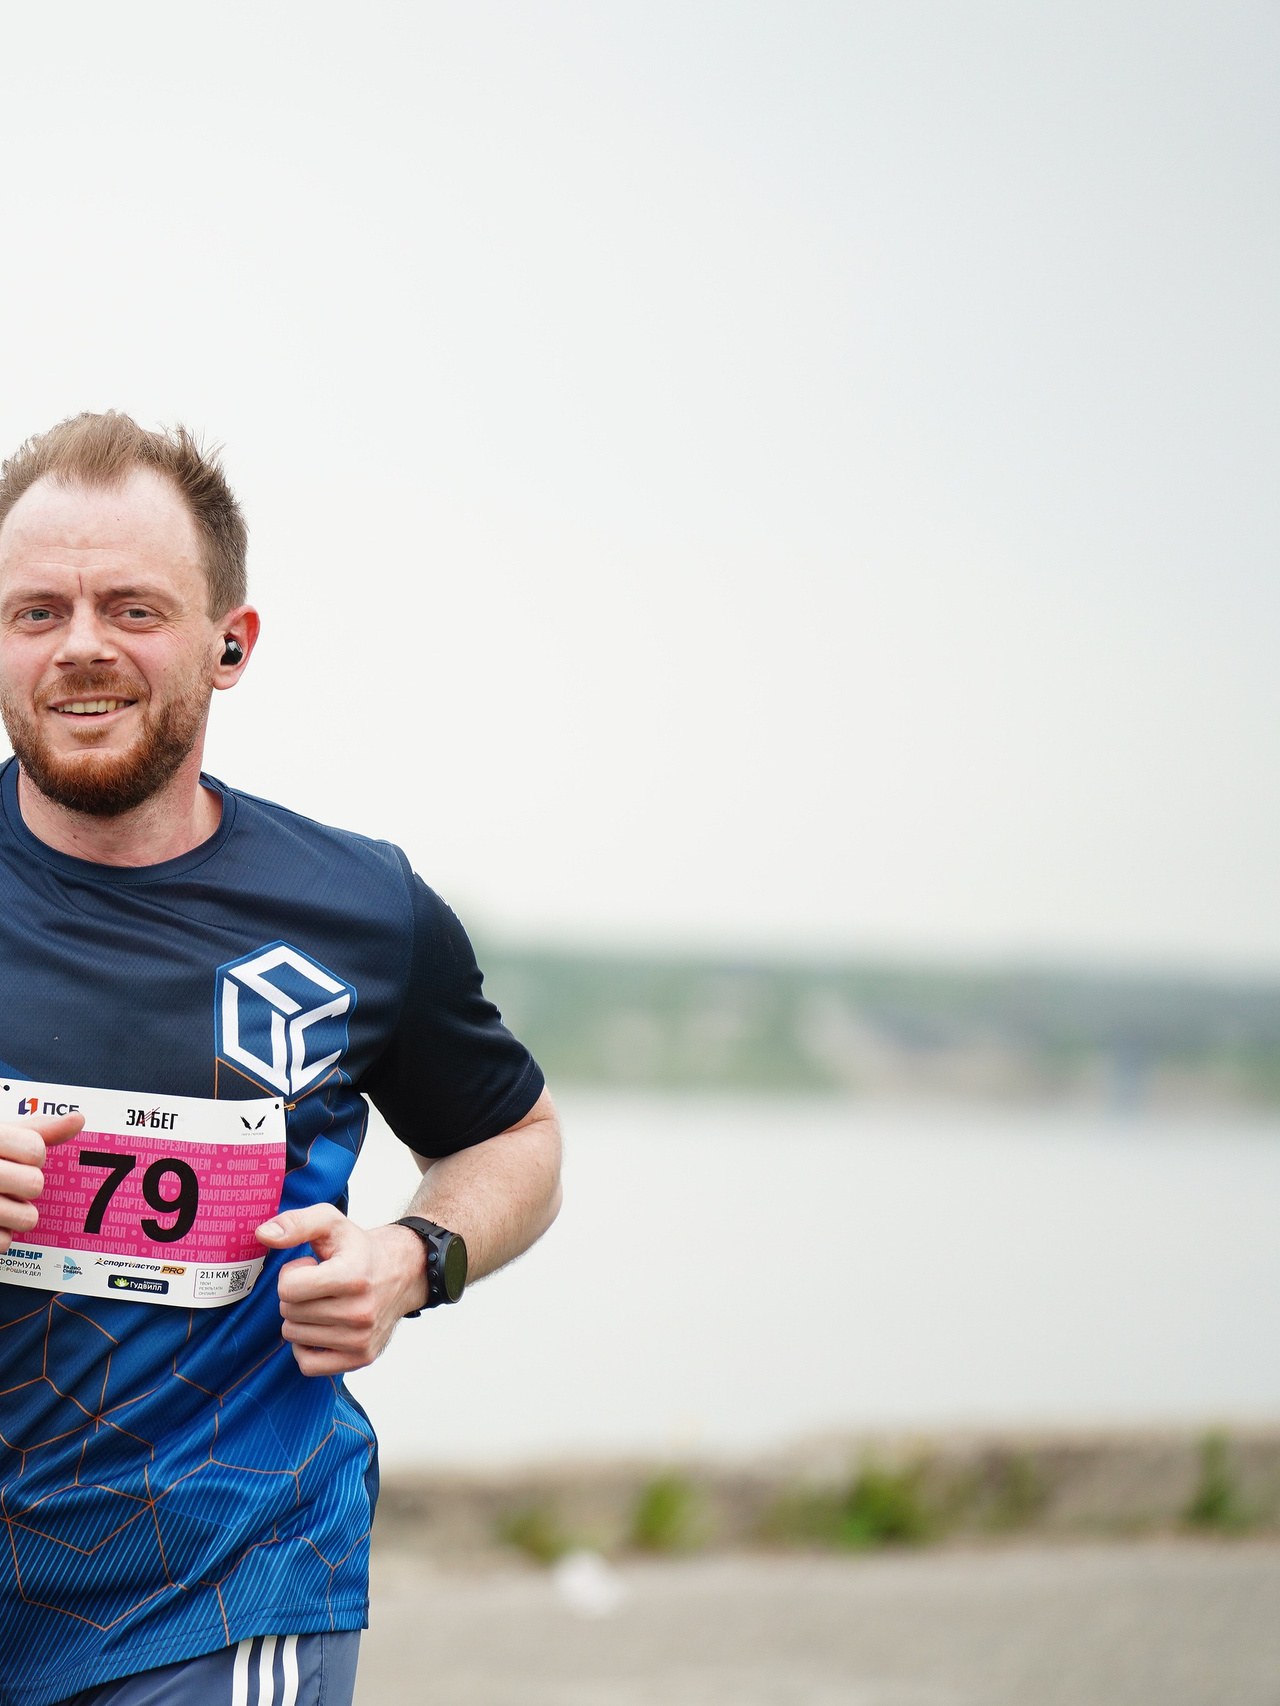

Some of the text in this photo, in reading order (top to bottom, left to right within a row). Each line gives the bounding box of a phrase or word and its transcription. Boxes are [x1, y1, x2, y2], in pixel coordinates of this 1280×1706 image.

[74, 1131, 99, 1144] АМКИ
[115, 1135, 153, 1149] БЕГОВАЯ
[154, 1139, 218, 1156] ПЕРЕЗАГРУЗКА
[233, 1144, 263, 1156] СТРЕСС
[43, 1157, 54, 1170] БЕ
[68, 1160, 112, 1175] КИЛОМЕТ
[226, 1159, 258, 1171] ФИНИШ
[267, 1157, 286, 1170] ТОЛЬ
[43, 1173, 64, 1187] СТАЛ
[210, 1174, 270, 1186] ПОКА ВСЕ СПЯТ
[124, 1181, 135, 1194] ЗА
[52, 1190, 86, 1204] НАЧАЛО
[79, 1150, 199, 1243] 79
[198, 1188, 277, 1202] ОВАЯ ПЕРЕЗАГРУЗКА
[113, 1196, 144, 1210] СТАРТЕ
[50, 1205, 66, 1217] БЕГ
[66, 1207, 72, 1218] В
[197, 1204, 271, 1218] ЕГУ ВСЕМ СЕРДЦЕМ
[37, 1218, 63, 1231] ТРЕСС
[100, 1224, 126, 1238] ТСТАЛ
[23, 1232, 59, 1247] ФИНИШ
[69, 1236, 102, 1250] ТОЛЬКО
[103, 1240, 138, 1255] НАЧАЛО
[151, 1246, 163, 1259] НА
[164, 1247, 195, 1261] СТАРТЕ
[196, 1250, 227, 1262] ЖИЗНИ
[186, 1234, 198, 1246] ЗА
[198, 1234, 227, 1247] РАМКИ
[1, 1248, 43, 1260] ИБУР
[161, 1266, 185, 1275] PRO
[200, 1271, 214, 1279] 21.1
